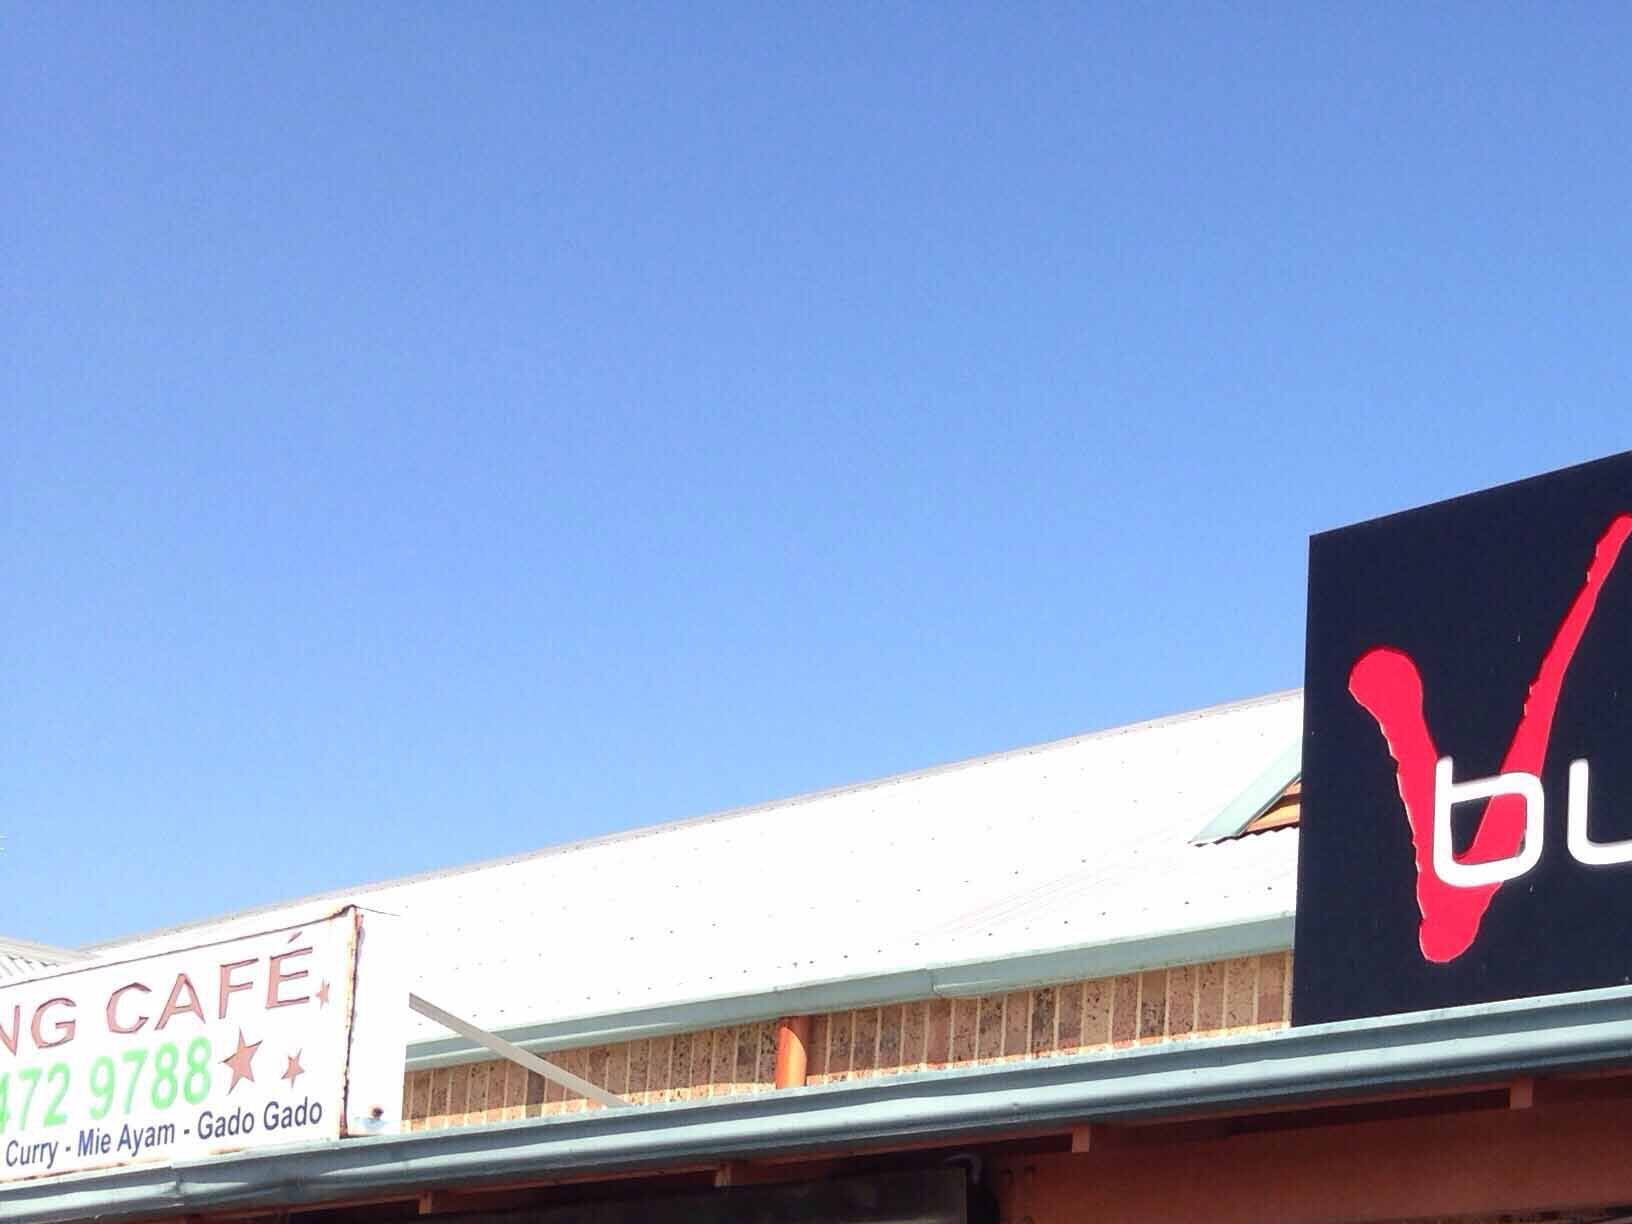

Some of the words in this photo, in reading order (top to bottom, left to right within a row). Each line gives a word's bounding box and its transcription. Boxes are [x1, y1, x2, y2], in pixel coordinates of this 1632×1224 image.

[106, 930, 314, 1034] CAFÉ
[88, 1036, 213, 1121] 9788
[6, 1139, 59, 1169] Curry
[77, 1127, 111, 1158] Mie
[118, 1121, 176, 1158] Ayam
[197, 1107, 255, 1140] Gado
[263, 1096, 323, 1129] Gado
